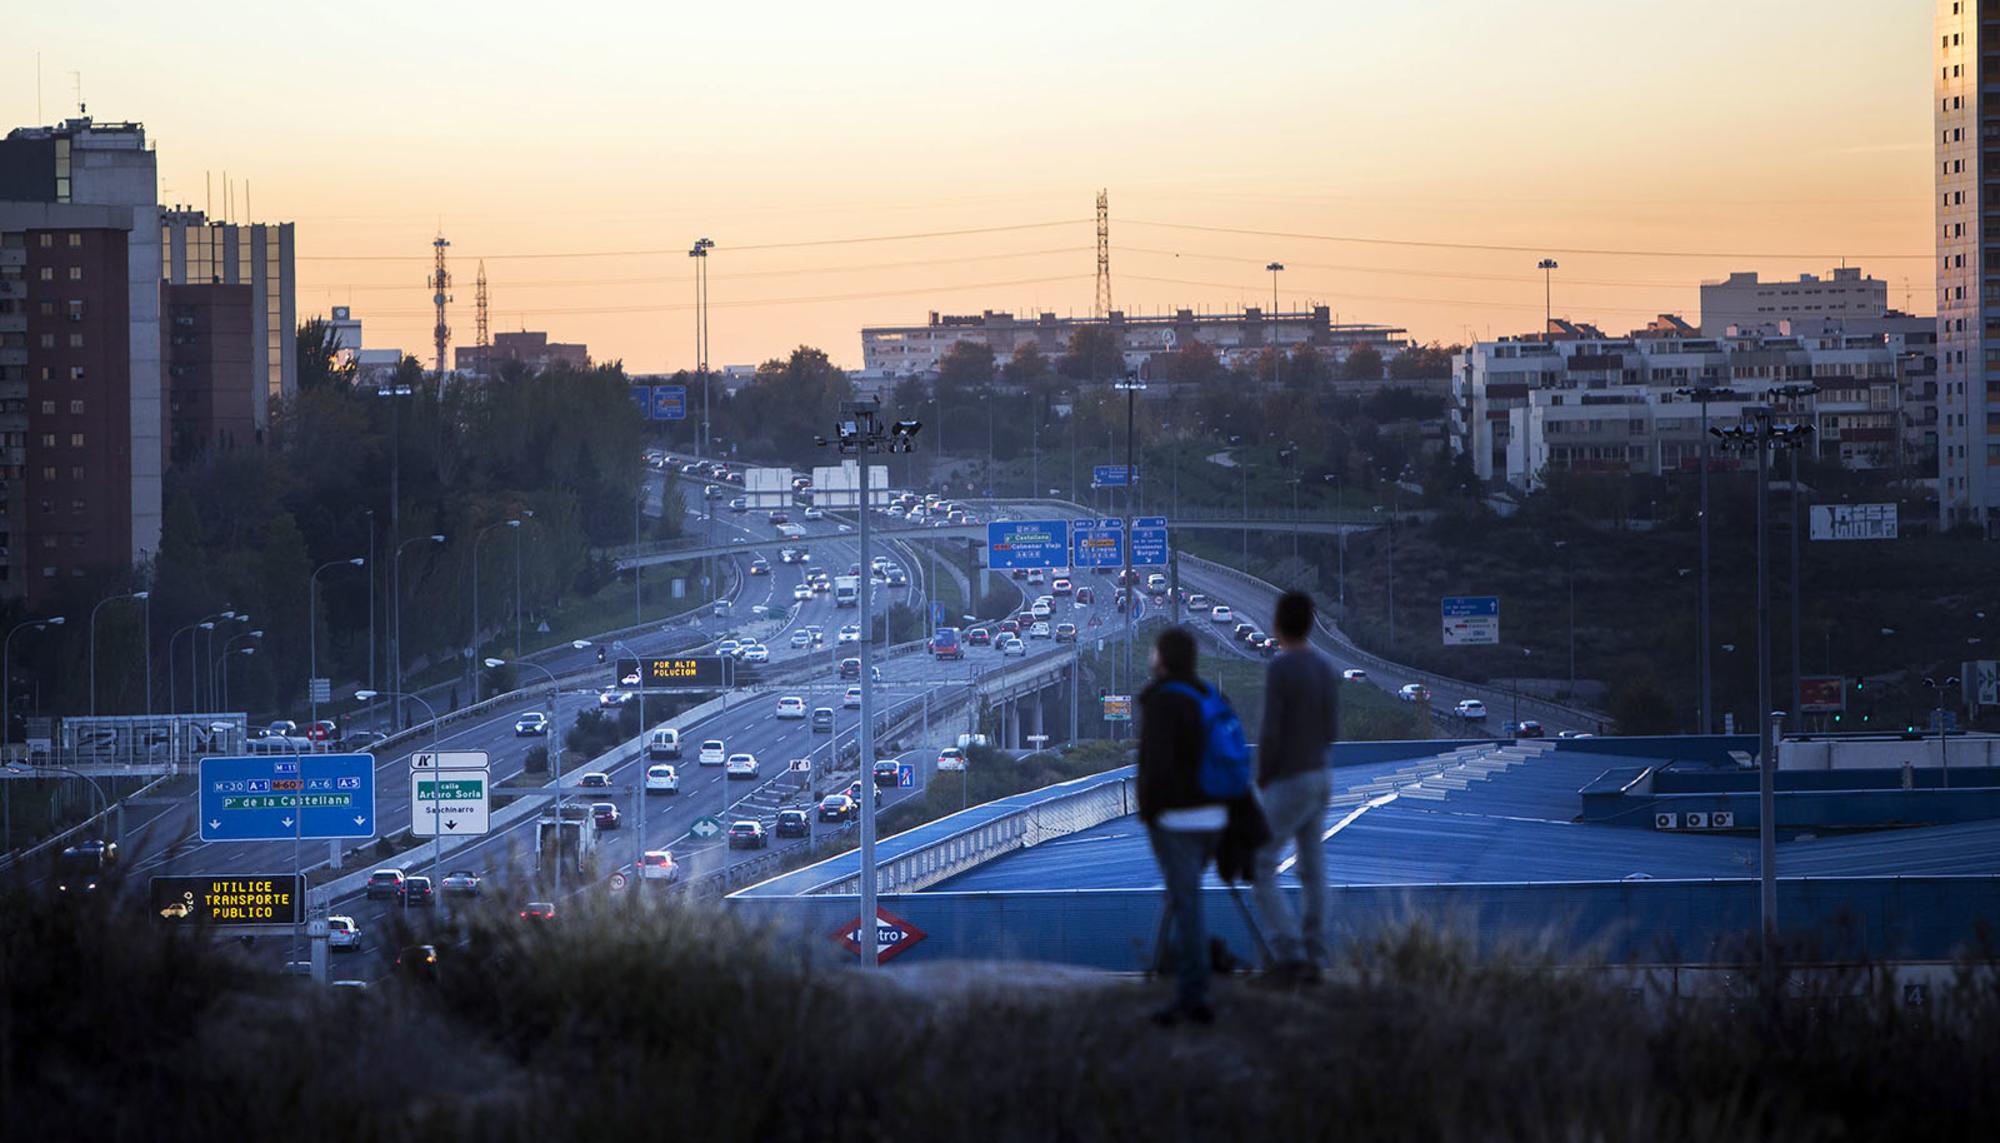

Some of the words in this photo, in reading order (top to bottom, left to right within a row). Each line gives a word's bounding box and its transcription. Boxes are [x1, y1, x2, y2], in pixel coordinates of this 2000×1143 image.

[675, 660, 697, 668] ALTA
[653, 668, 697, 676] POLUCION
[215, 783, 243, 792] M-30
[250, 779, 269, 790] A-1
[309, 779, 330, 788] A-6
[340, 778, 359, 788] A-5
[455, 790, 482, 798] Soria
[243, 798, 257, 807] de
[263, 796, 274, 806] la
[213, 881, 272, 892] UTILICE
[205, 894, 289, 906] TRANSPORTE
[213, 907, 273, 918] PUBLICO
[857, 929, 899, 942] tro
